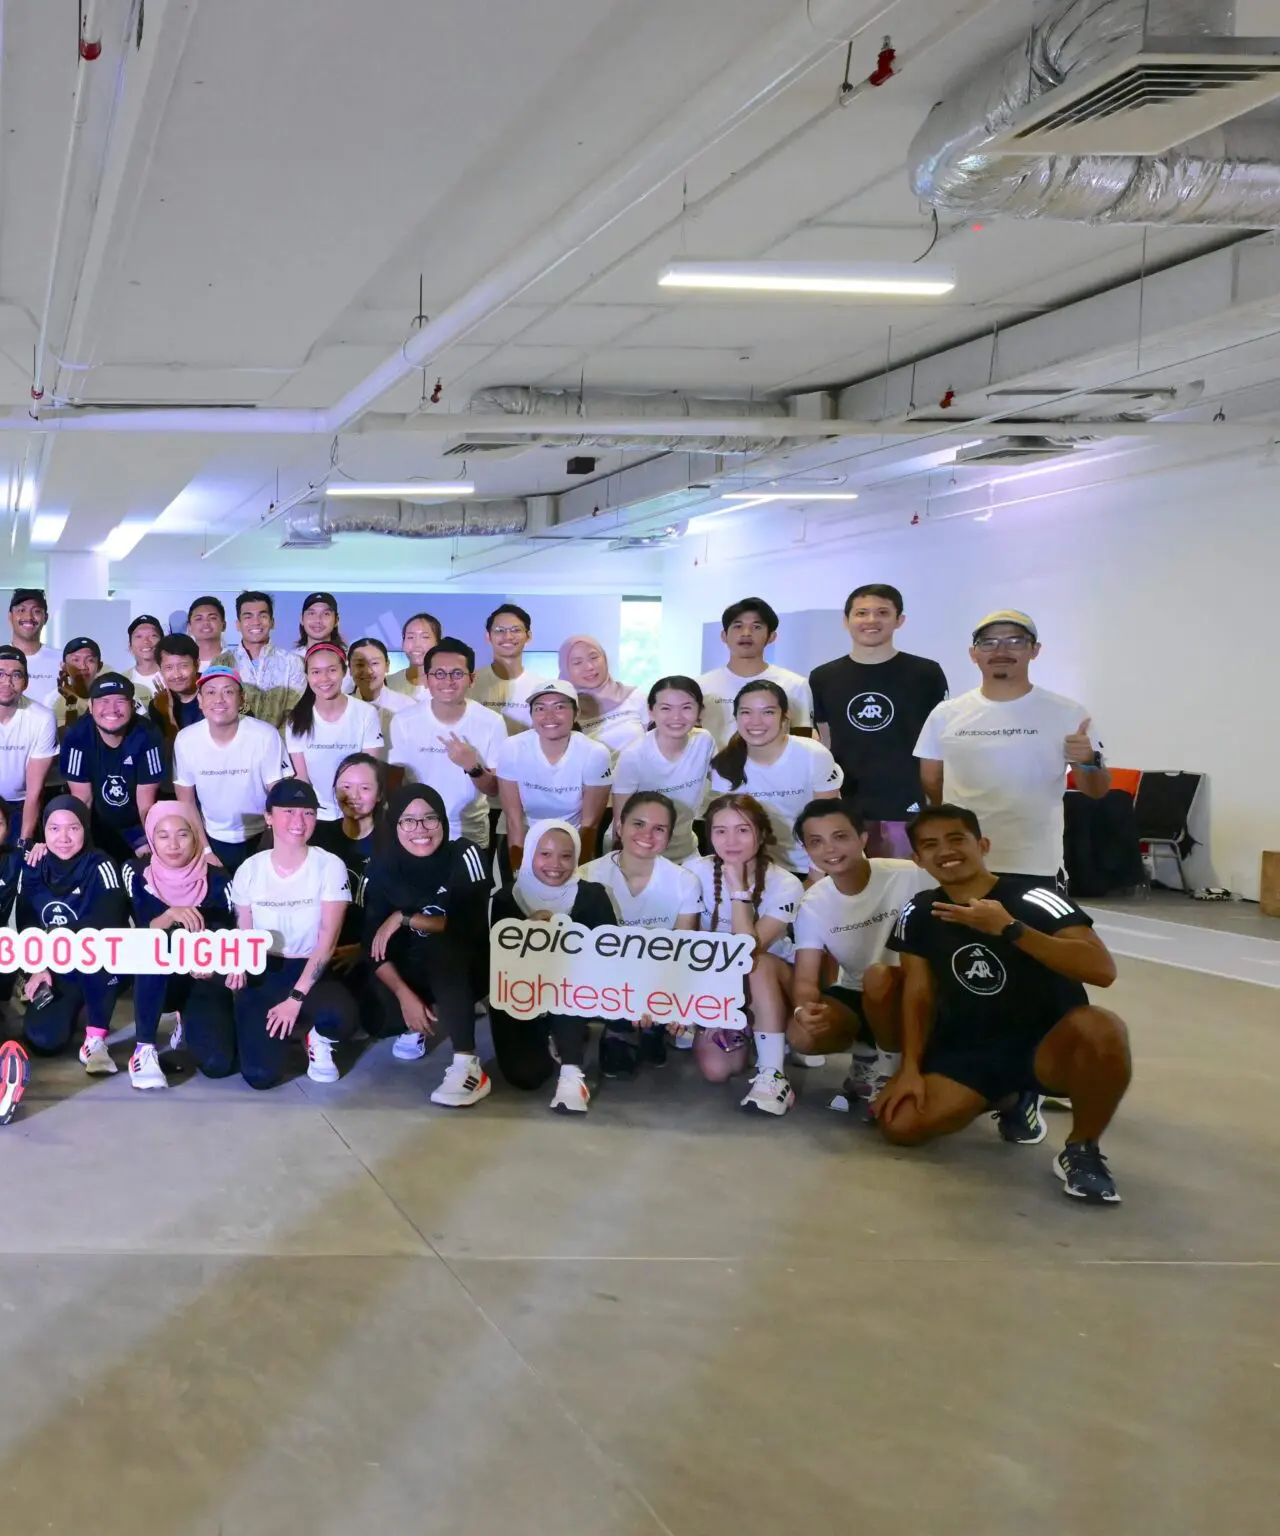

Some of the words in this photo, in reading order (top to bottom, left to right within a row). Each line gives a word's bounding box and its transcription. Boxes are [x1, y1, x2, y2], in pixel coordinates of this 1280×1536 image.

[955, 728, 1001, 736] ultraboost
[1002, 727, 1022, 738] light
[830, 919, 873, 934] ultraboost
[872, 911, 889, 923] light
[154, 937, 265, 968] LIGHT
[498, 921, 585, 958] epic
[595, 932, 746, 973] energy.
[497, 971, 636, 1014] lightest
[646, 991, 739, 1024] ever.
